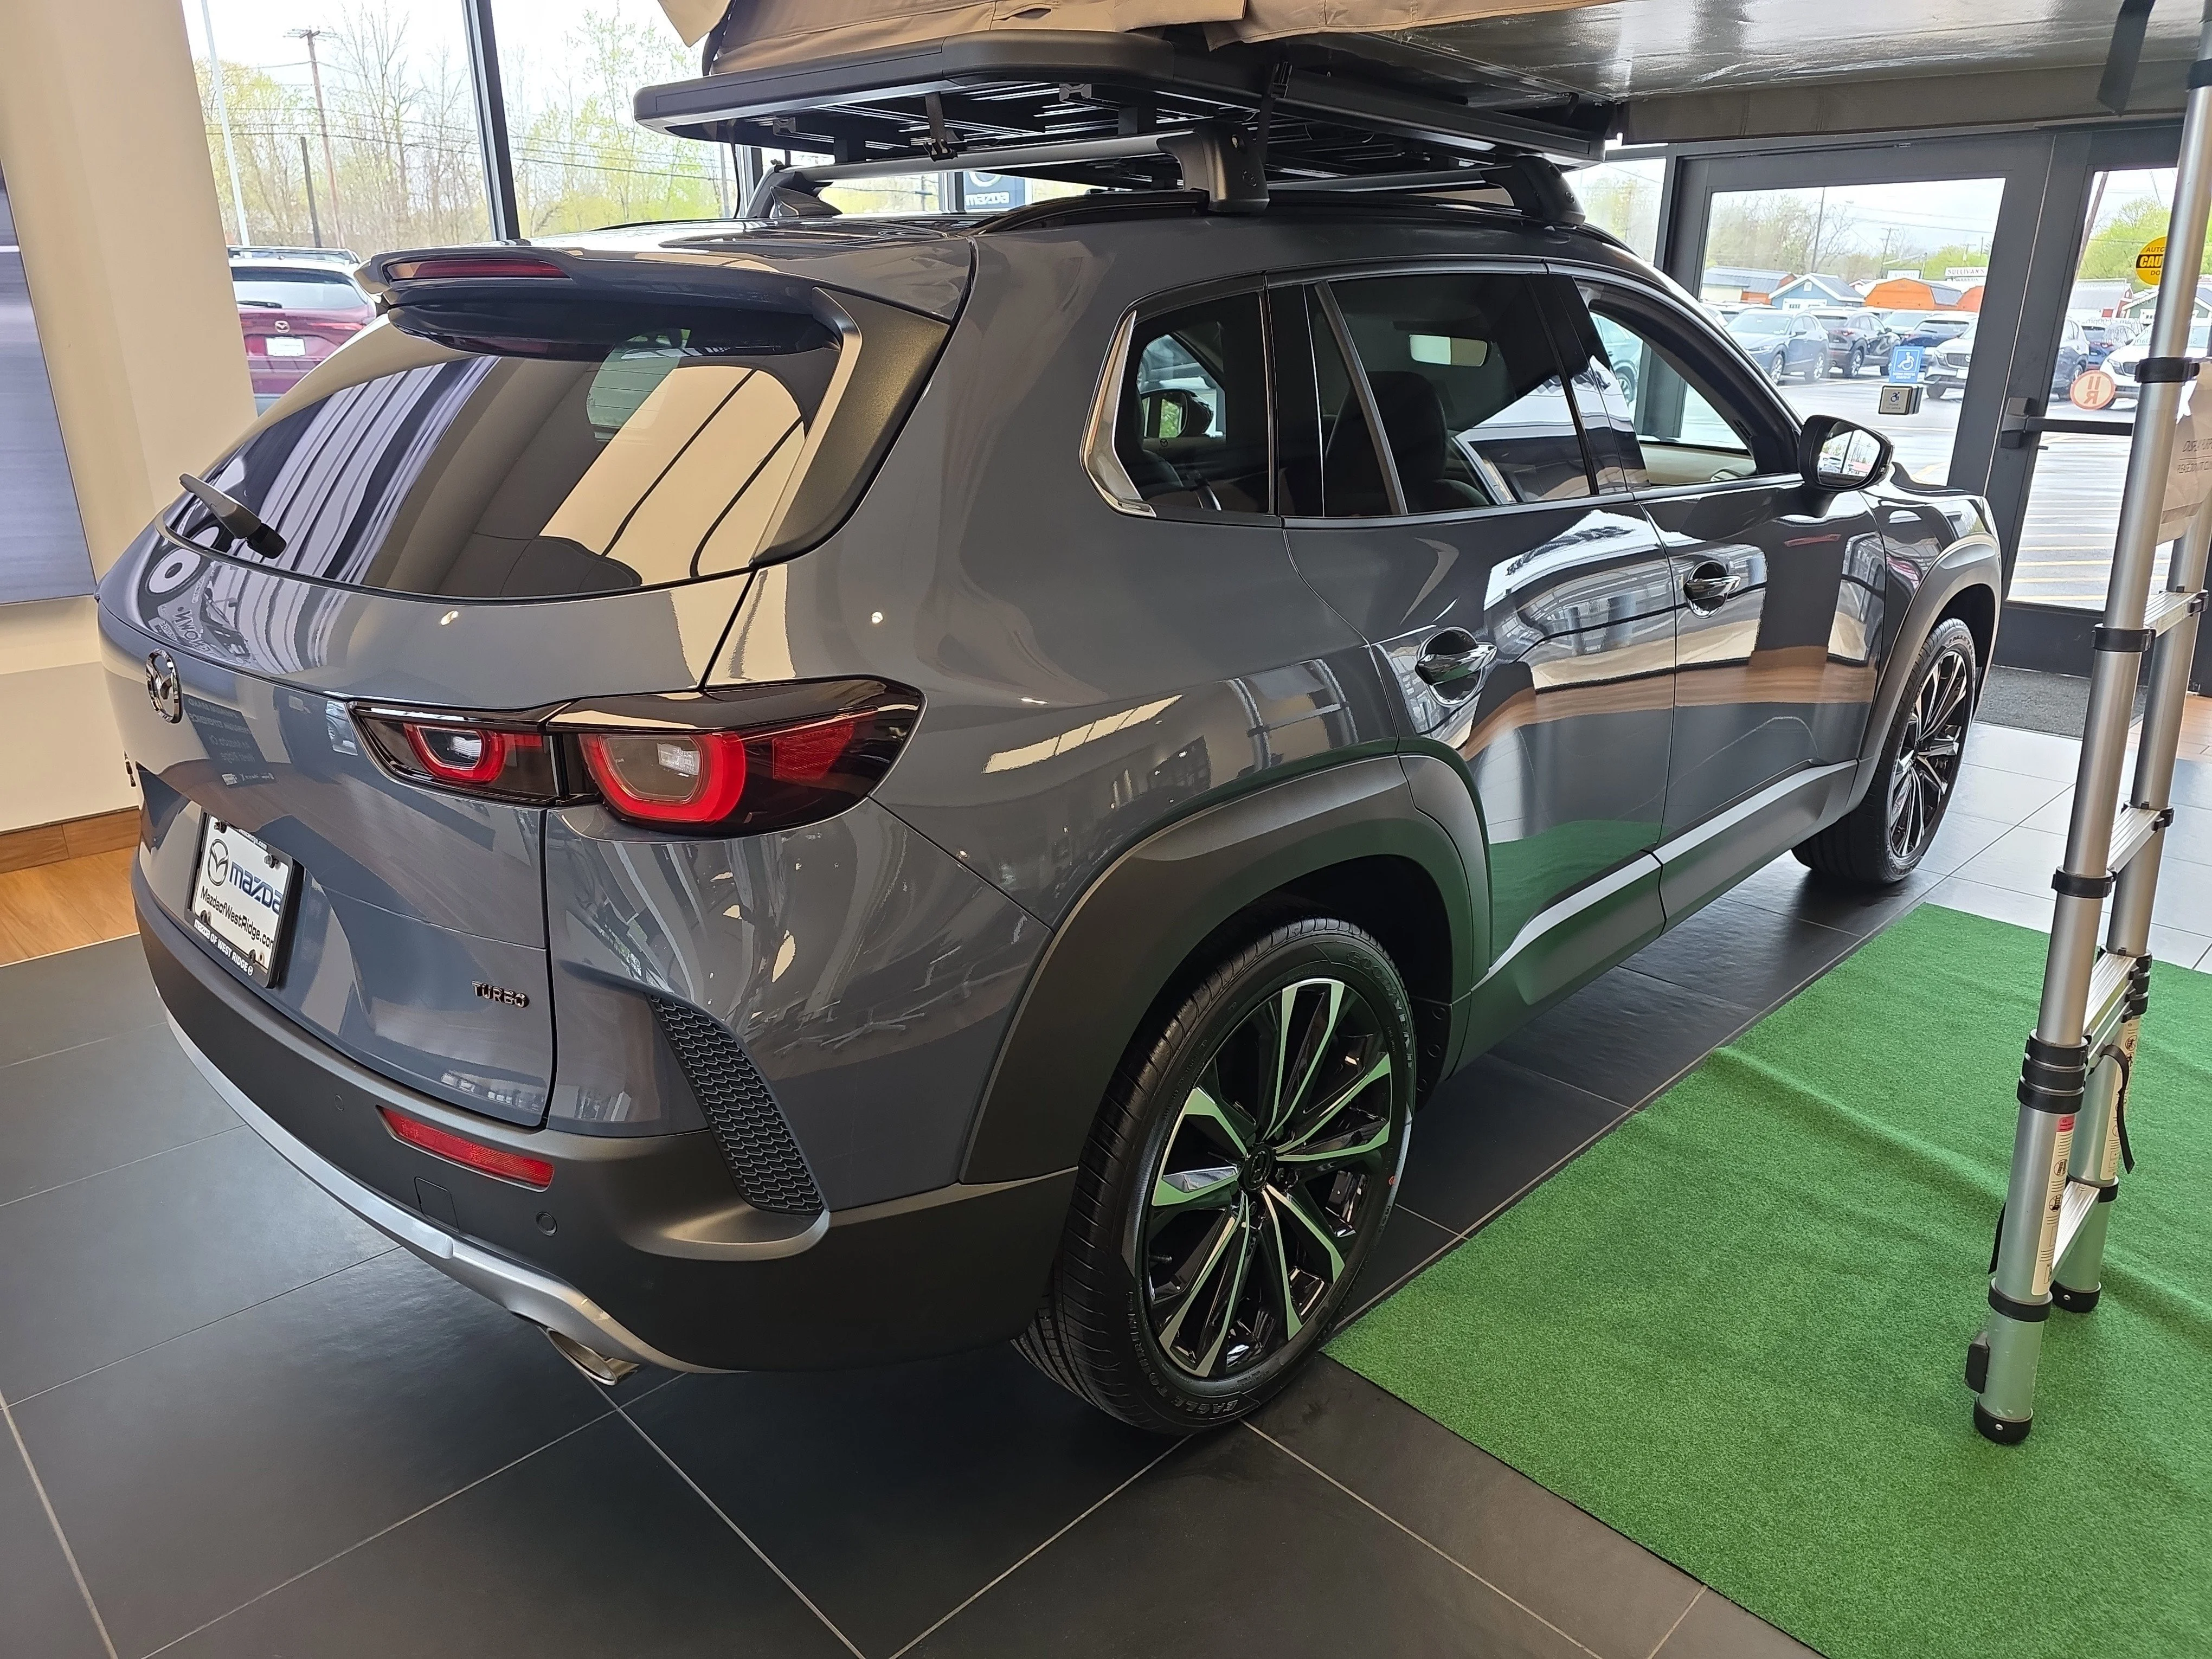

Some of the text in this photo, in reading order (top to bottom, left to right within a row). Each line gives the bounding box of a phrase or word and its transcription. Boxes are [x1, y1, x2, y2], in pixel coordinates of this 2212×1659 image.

[210, 933, 217, 944] OF
[217, 938, 232, 957] WEST
[232, 951, 248, 972] RIDGE
[471, 980, 530, 1008] TURBO
[1170, 1399, 1239, 1414] EAGLE
